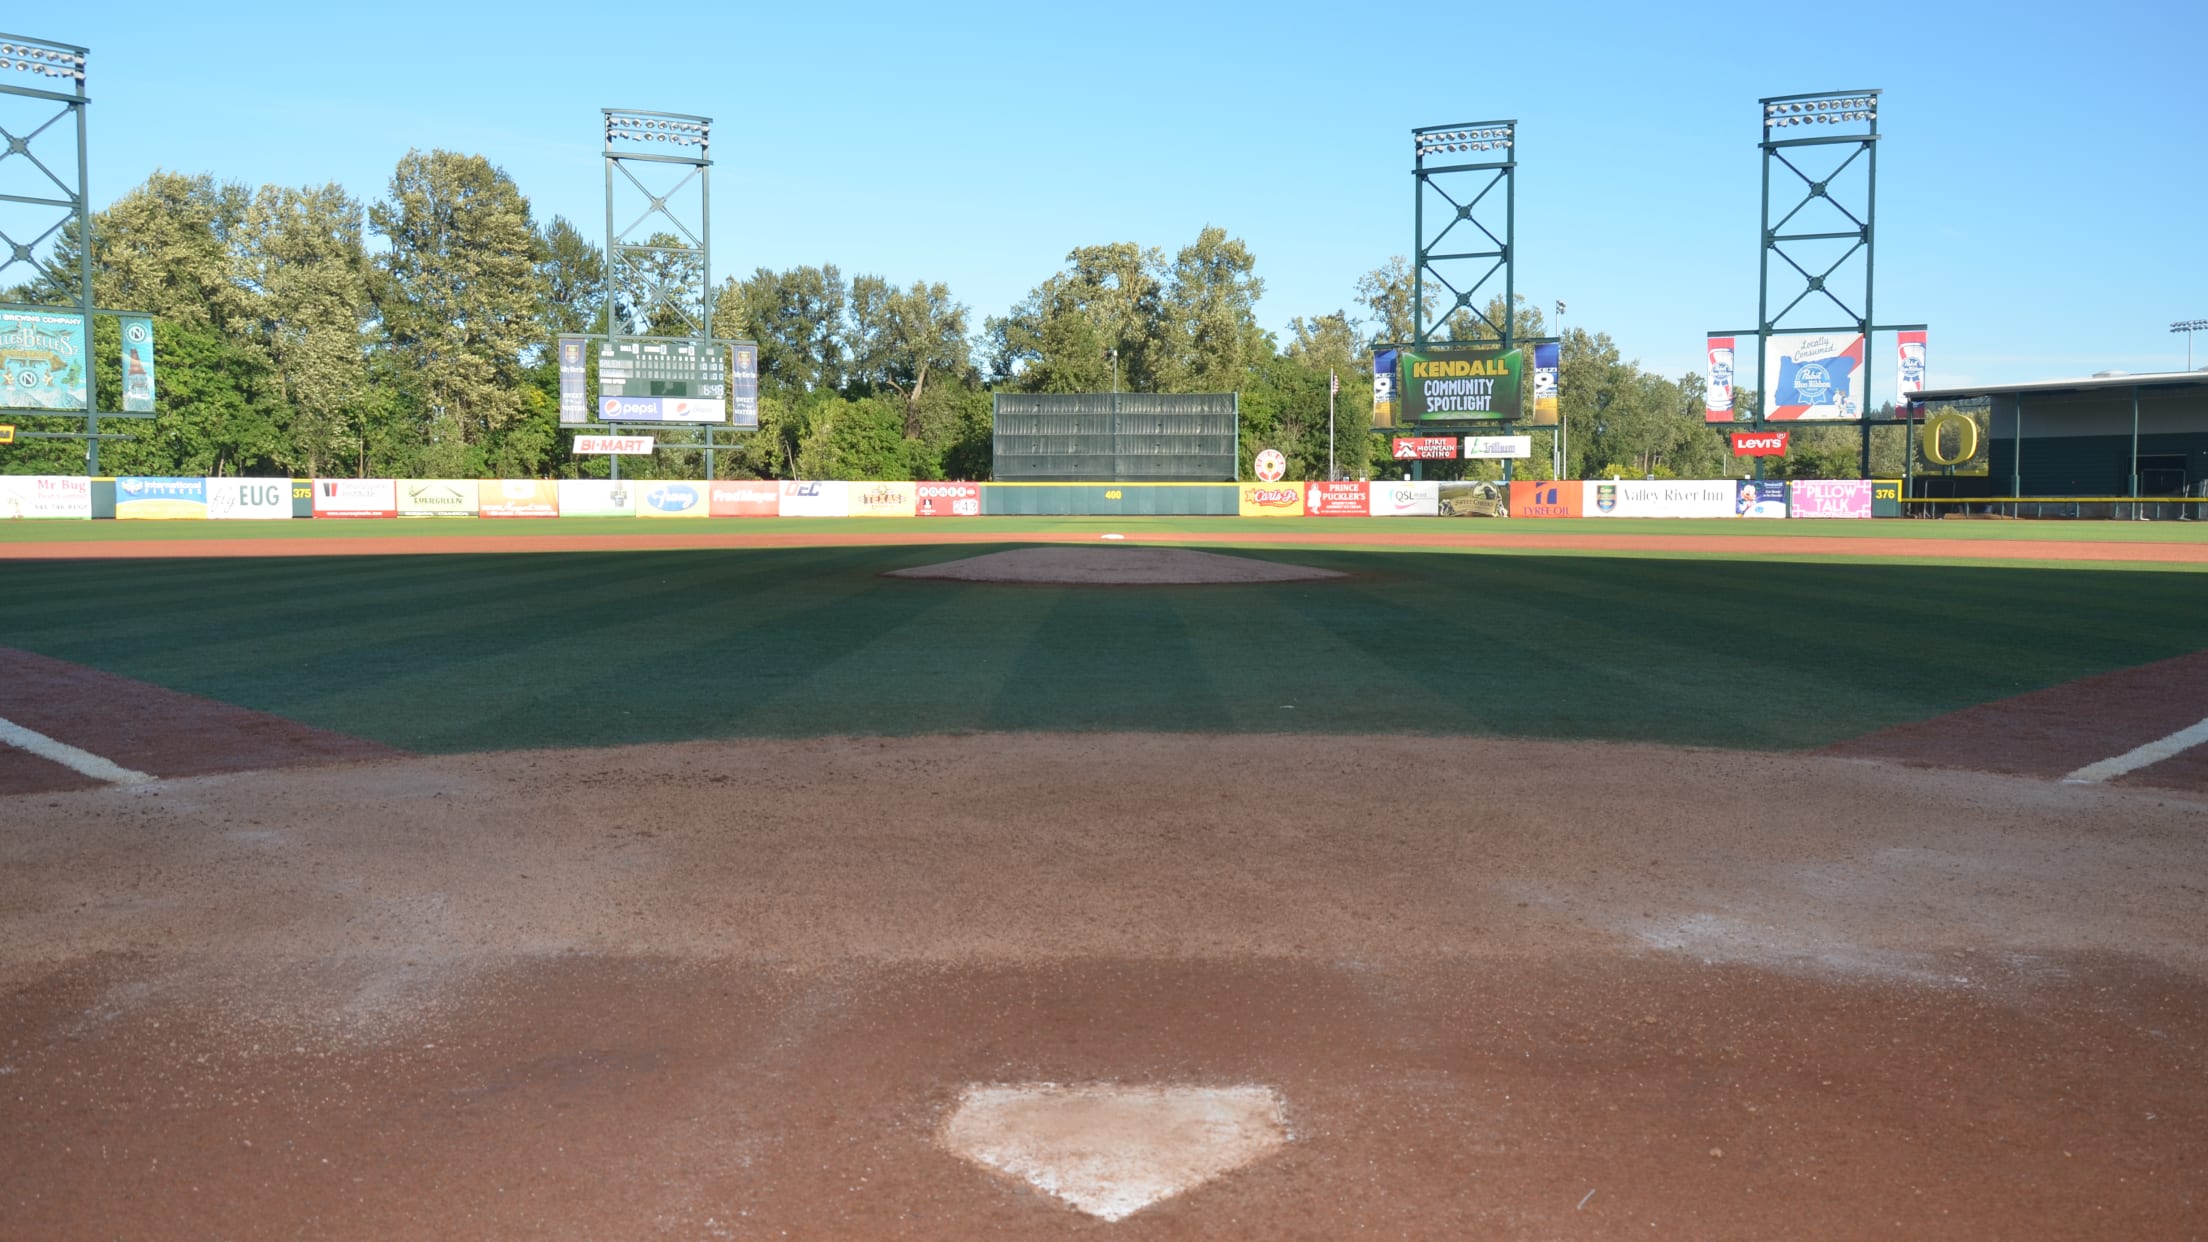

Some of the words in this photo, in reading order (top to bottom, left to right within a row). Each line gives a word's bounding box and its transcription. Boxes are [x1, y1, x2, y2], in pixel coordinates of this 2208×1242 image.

[3, 314, 41, 322] BREWING
[42, 317, 81, 325] COMPANY
[1801, 336, 1829, 350] Locally
[1413, 359, 1509, 378] KENDALL
[1424, 379, 1495, 397] COMMUNITY
[623, 402, 657, 416] pepsi
[1427, 396, 1491, 412] SPOTLIGHT
[1923, 415, 1978, 465] O
[62, 479, 87, 493] Bug
[293, 488, 312, 498] 375
[1806, 485, 1857, 498] PILLOW
[239, 485, 280, 506] EUG
[713, 489, 740, 501] Fred
[740, 489, 777, 504] Meyer
[1104, 490, 1122, 500] 400
[1255, 489, 1281, 501] Carl's
[1281, 488, 1299, 502] Jr.
[1395, 490, 1414, 502] QSL
[1624, 488, 1659, 504] Valley
[1664, 488, 1699, 501] River
[1702, 488, 1724, 502] Inn
[1876, 489, 1895, 499] 376
[1553, 506, 1568, 515] OIL
[1814, 498, 1849, 511] TALK
